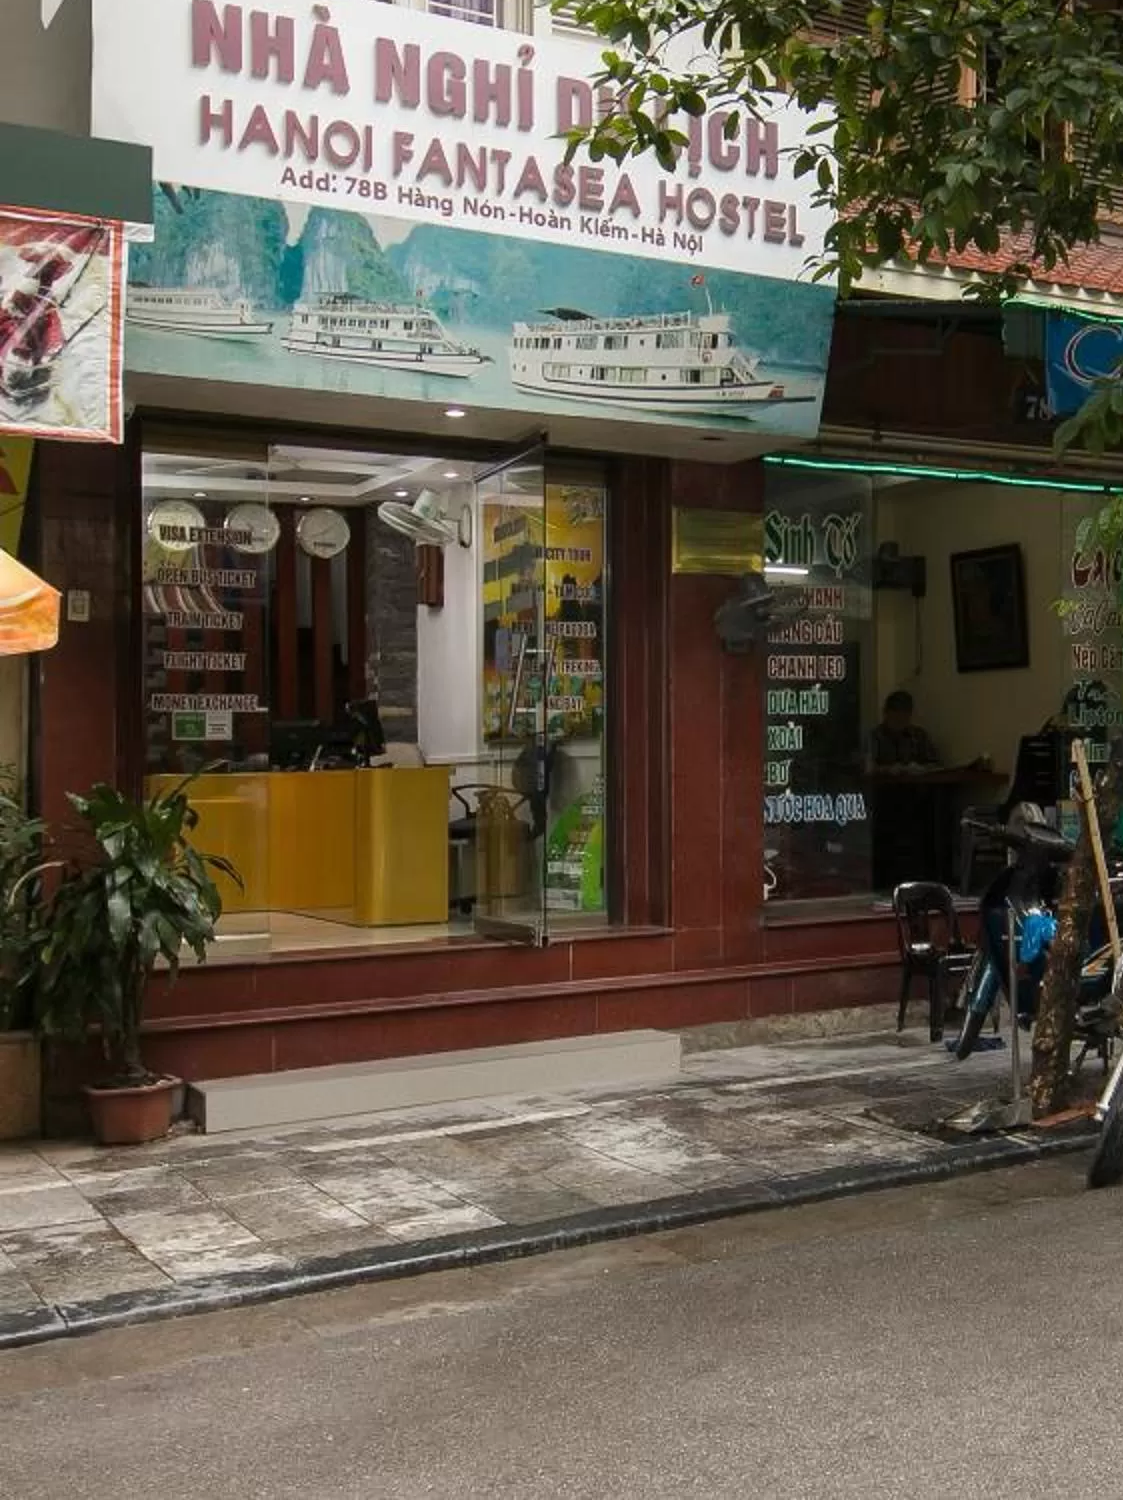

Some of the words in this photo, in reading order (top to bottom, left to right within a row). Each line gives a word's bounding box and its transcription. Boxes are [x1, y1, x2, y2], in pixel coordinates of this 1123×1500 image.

[376, 37, 534, 132] NGHỈ
[199, 95, 373, 174] HANOI
[393, 131, 641, 219] FANTASEA
[658, 179, 805, 248] HOSTEL
[281, 166, 337, 194] Add:
[345, 176, 388, 201] 78B
[398, 185, 454, 216] Hàng
[159, 524, 187, 542] VISA
[189, 527, 253, 545] EXTENSION
[765, 510, 816, 565] Sinh
[157, 569, 187, 585] OPEN
[191, 569, 215, 586] BUS
[218, 569, 257, 588] TICKET
[204, 611, 244, 629] TICKET
[205, 652, 247, 670] TICKET
[767, 654, 817, 679] CHANH
[818, 654, 847, 681] LEO
[152, 693, 197, 711] MONEY
[197, 693, 260, 712] EXCHANGE
[767, 720, 803, 751] XOÀI
[804, 793, 834, 821] HOA
